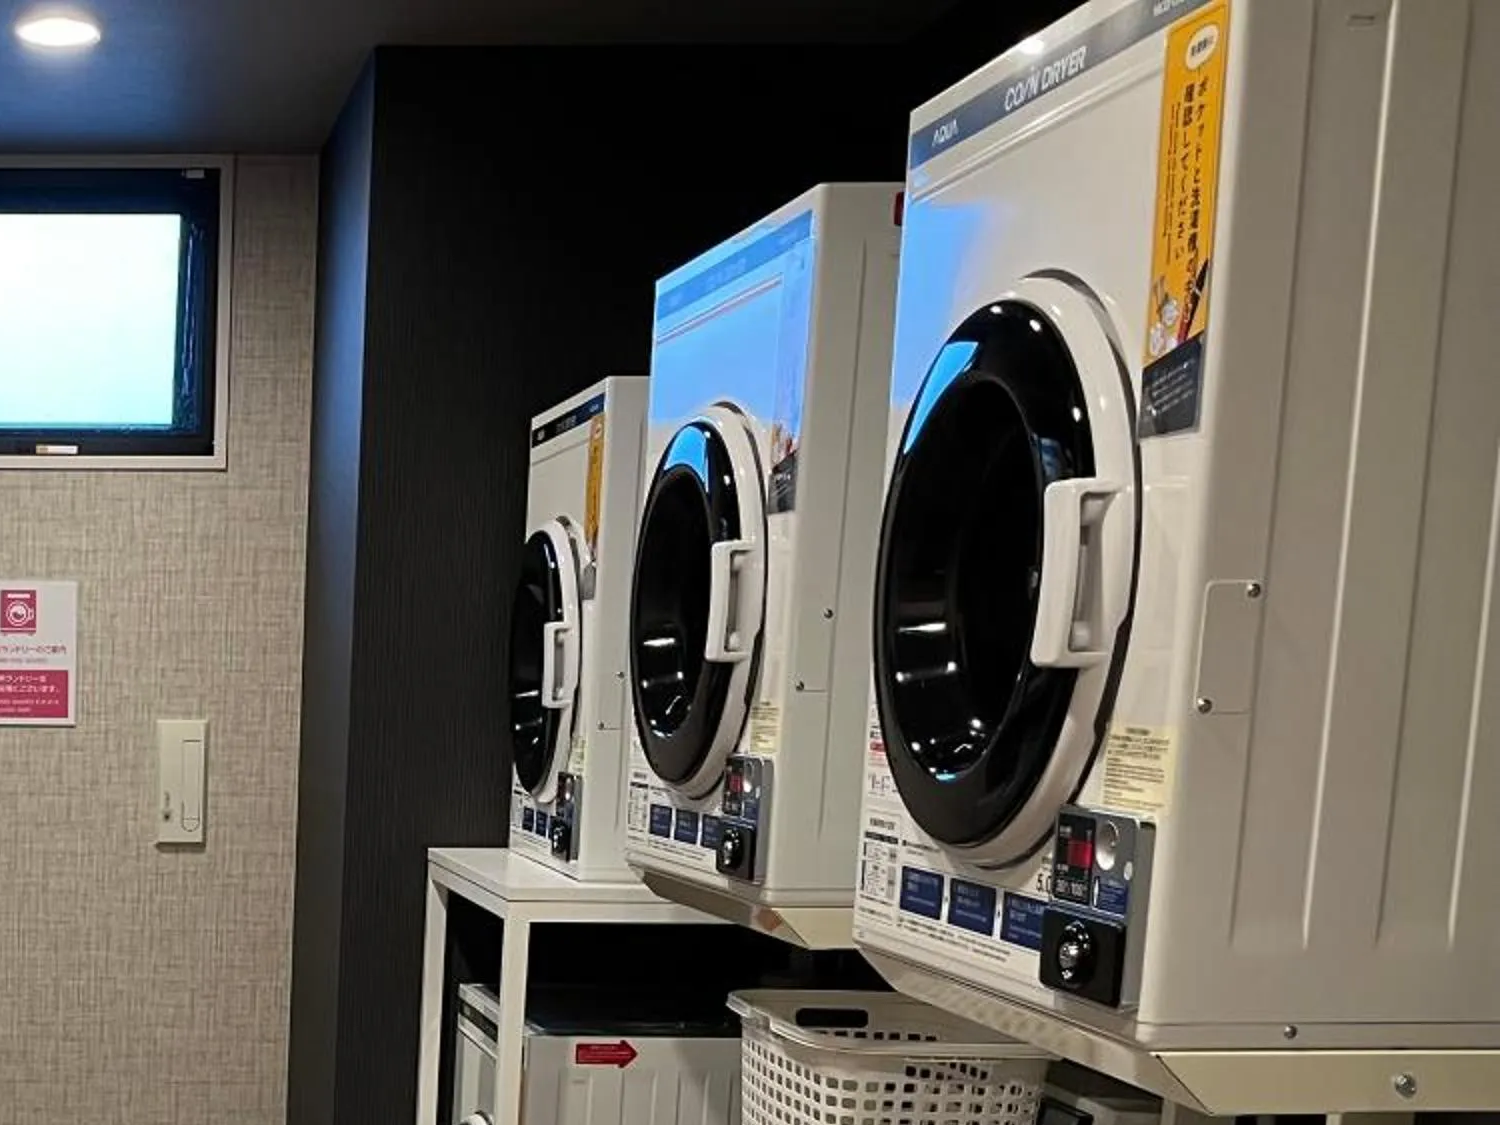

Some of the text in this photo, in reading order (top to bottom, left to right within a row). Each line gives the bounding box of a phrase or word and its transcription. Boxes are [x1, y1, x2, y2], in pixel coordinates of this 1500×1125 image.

[1004, 45, 1088, 111] COIN DRYER
[932, 119, 959, 148] AQUA
